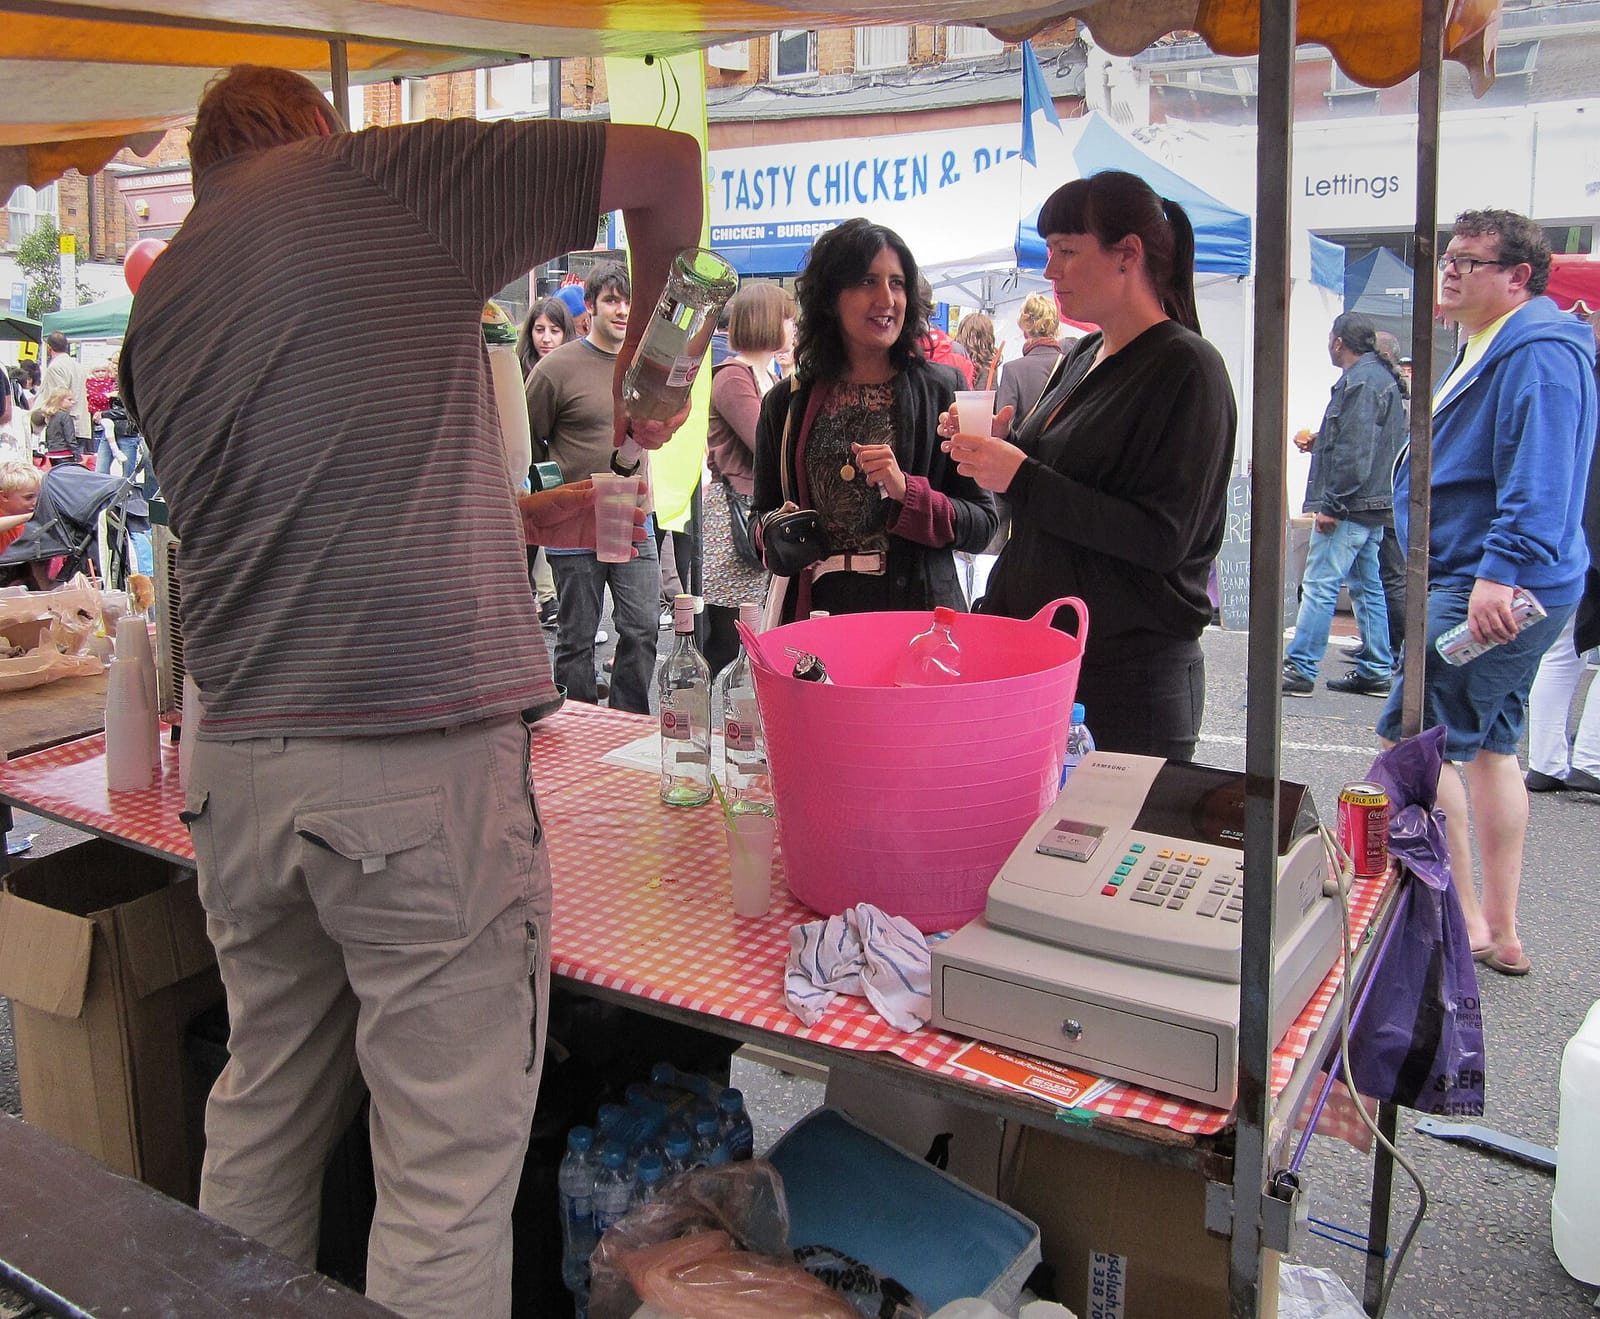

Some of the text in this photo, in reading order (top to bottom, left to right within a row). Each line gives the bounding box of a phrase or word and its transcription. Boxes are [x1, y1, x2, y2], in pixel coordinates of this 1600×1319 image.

[721, 165, 796, 211] TASTY
[807, 151, 928, 205] CHICKEN
[1305, 174, 1399, 199] Lettings
[711, 226, 765, 240] CHICKEN
[1092, 762, 1126, 771] SAMSUNG
